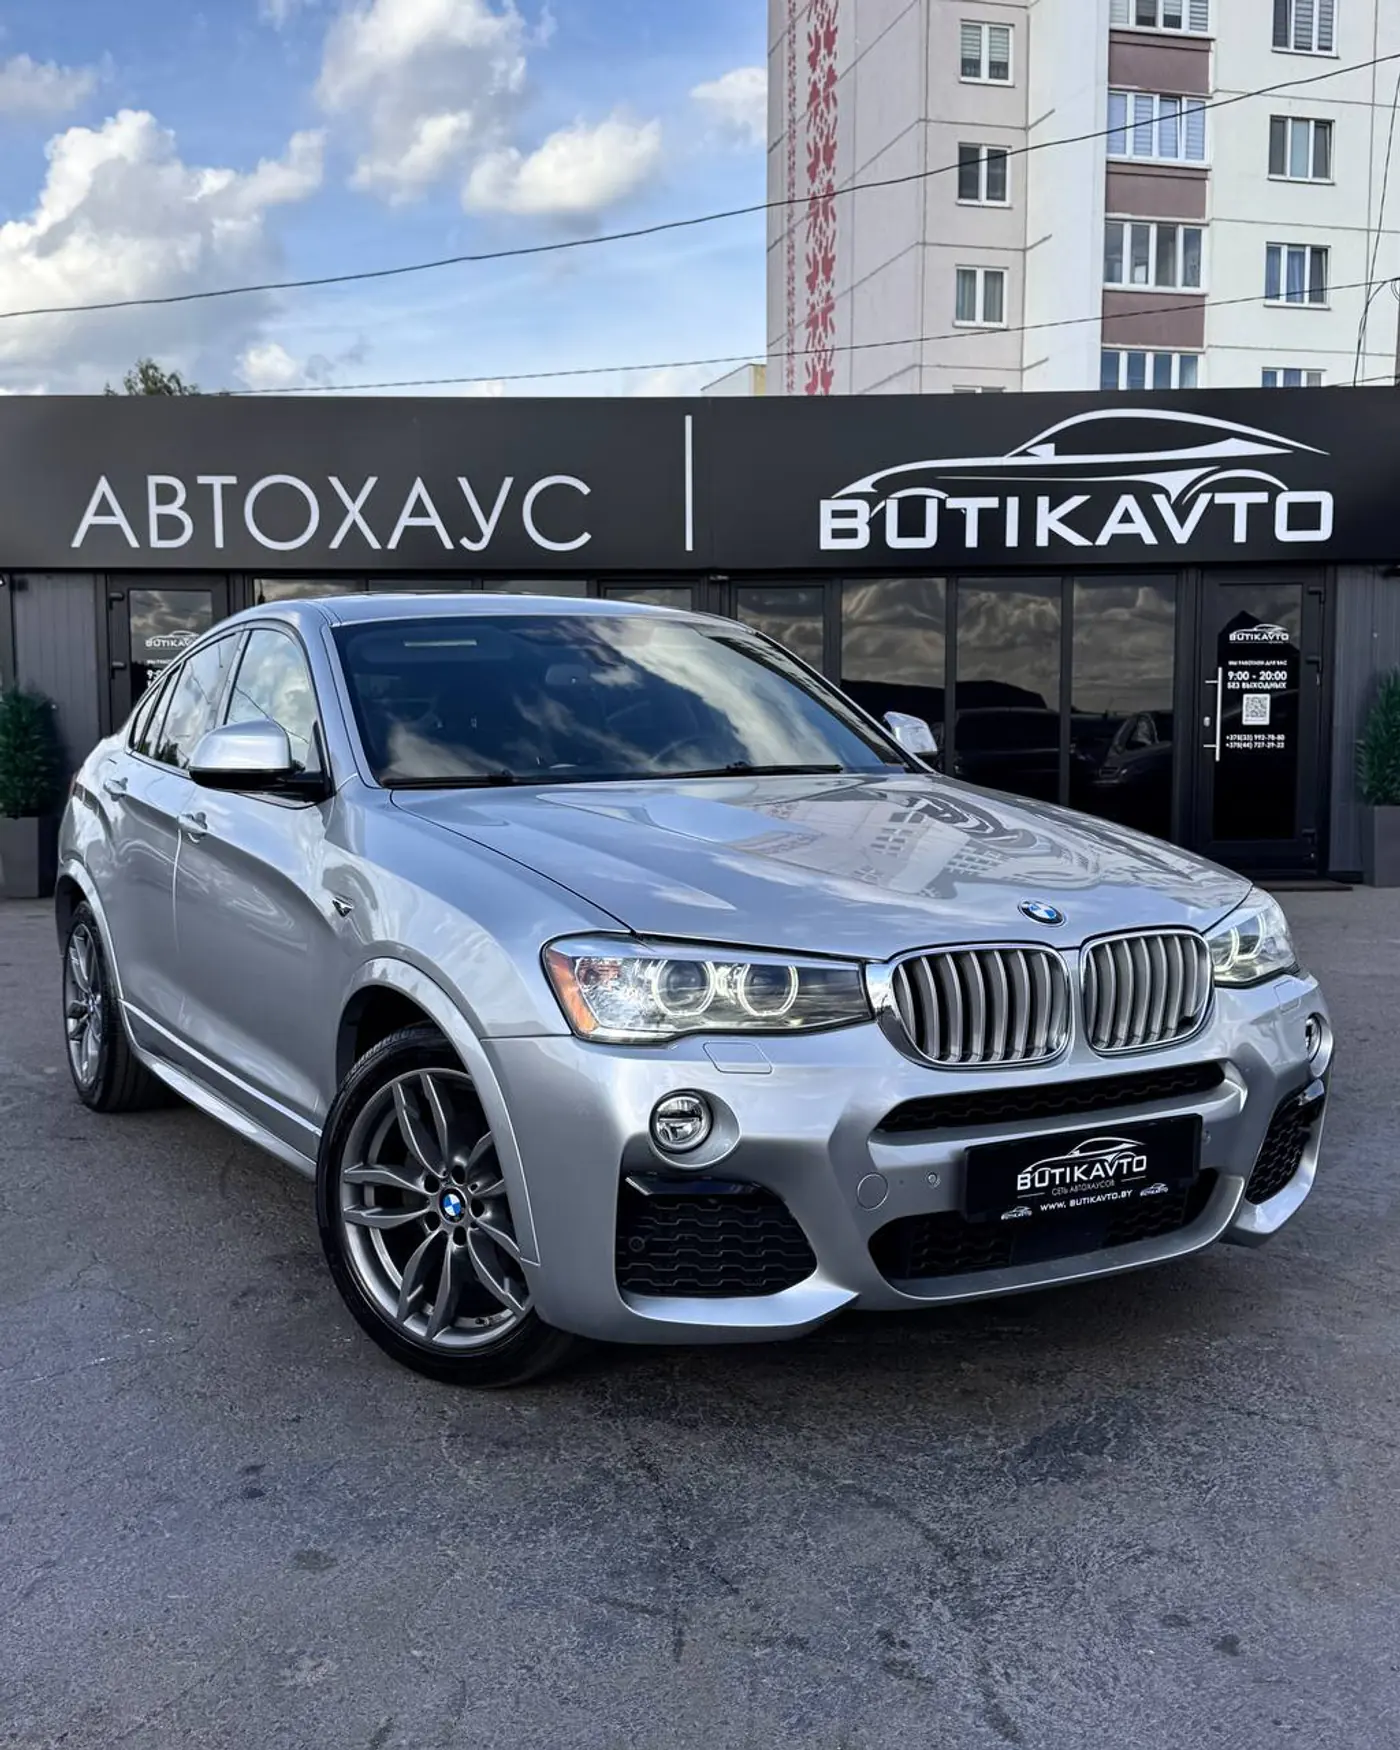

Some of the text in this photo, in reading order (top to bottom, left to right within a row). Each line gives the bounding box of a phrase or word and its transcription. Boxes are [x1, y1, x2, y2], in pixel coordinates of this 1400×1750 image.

[71, 474, 592, 552] АВТОХАУС
[819, 490, 1335, 550] BUTIKAVTO
[1229, 633, 1289, 641] BUTIKAVTO
[1227, 671, 1250, 681] 9:00
[1259, 671, 1288, 681] 20:00
[1017, 1155, 1147, 1191] BUTIKAVTO
